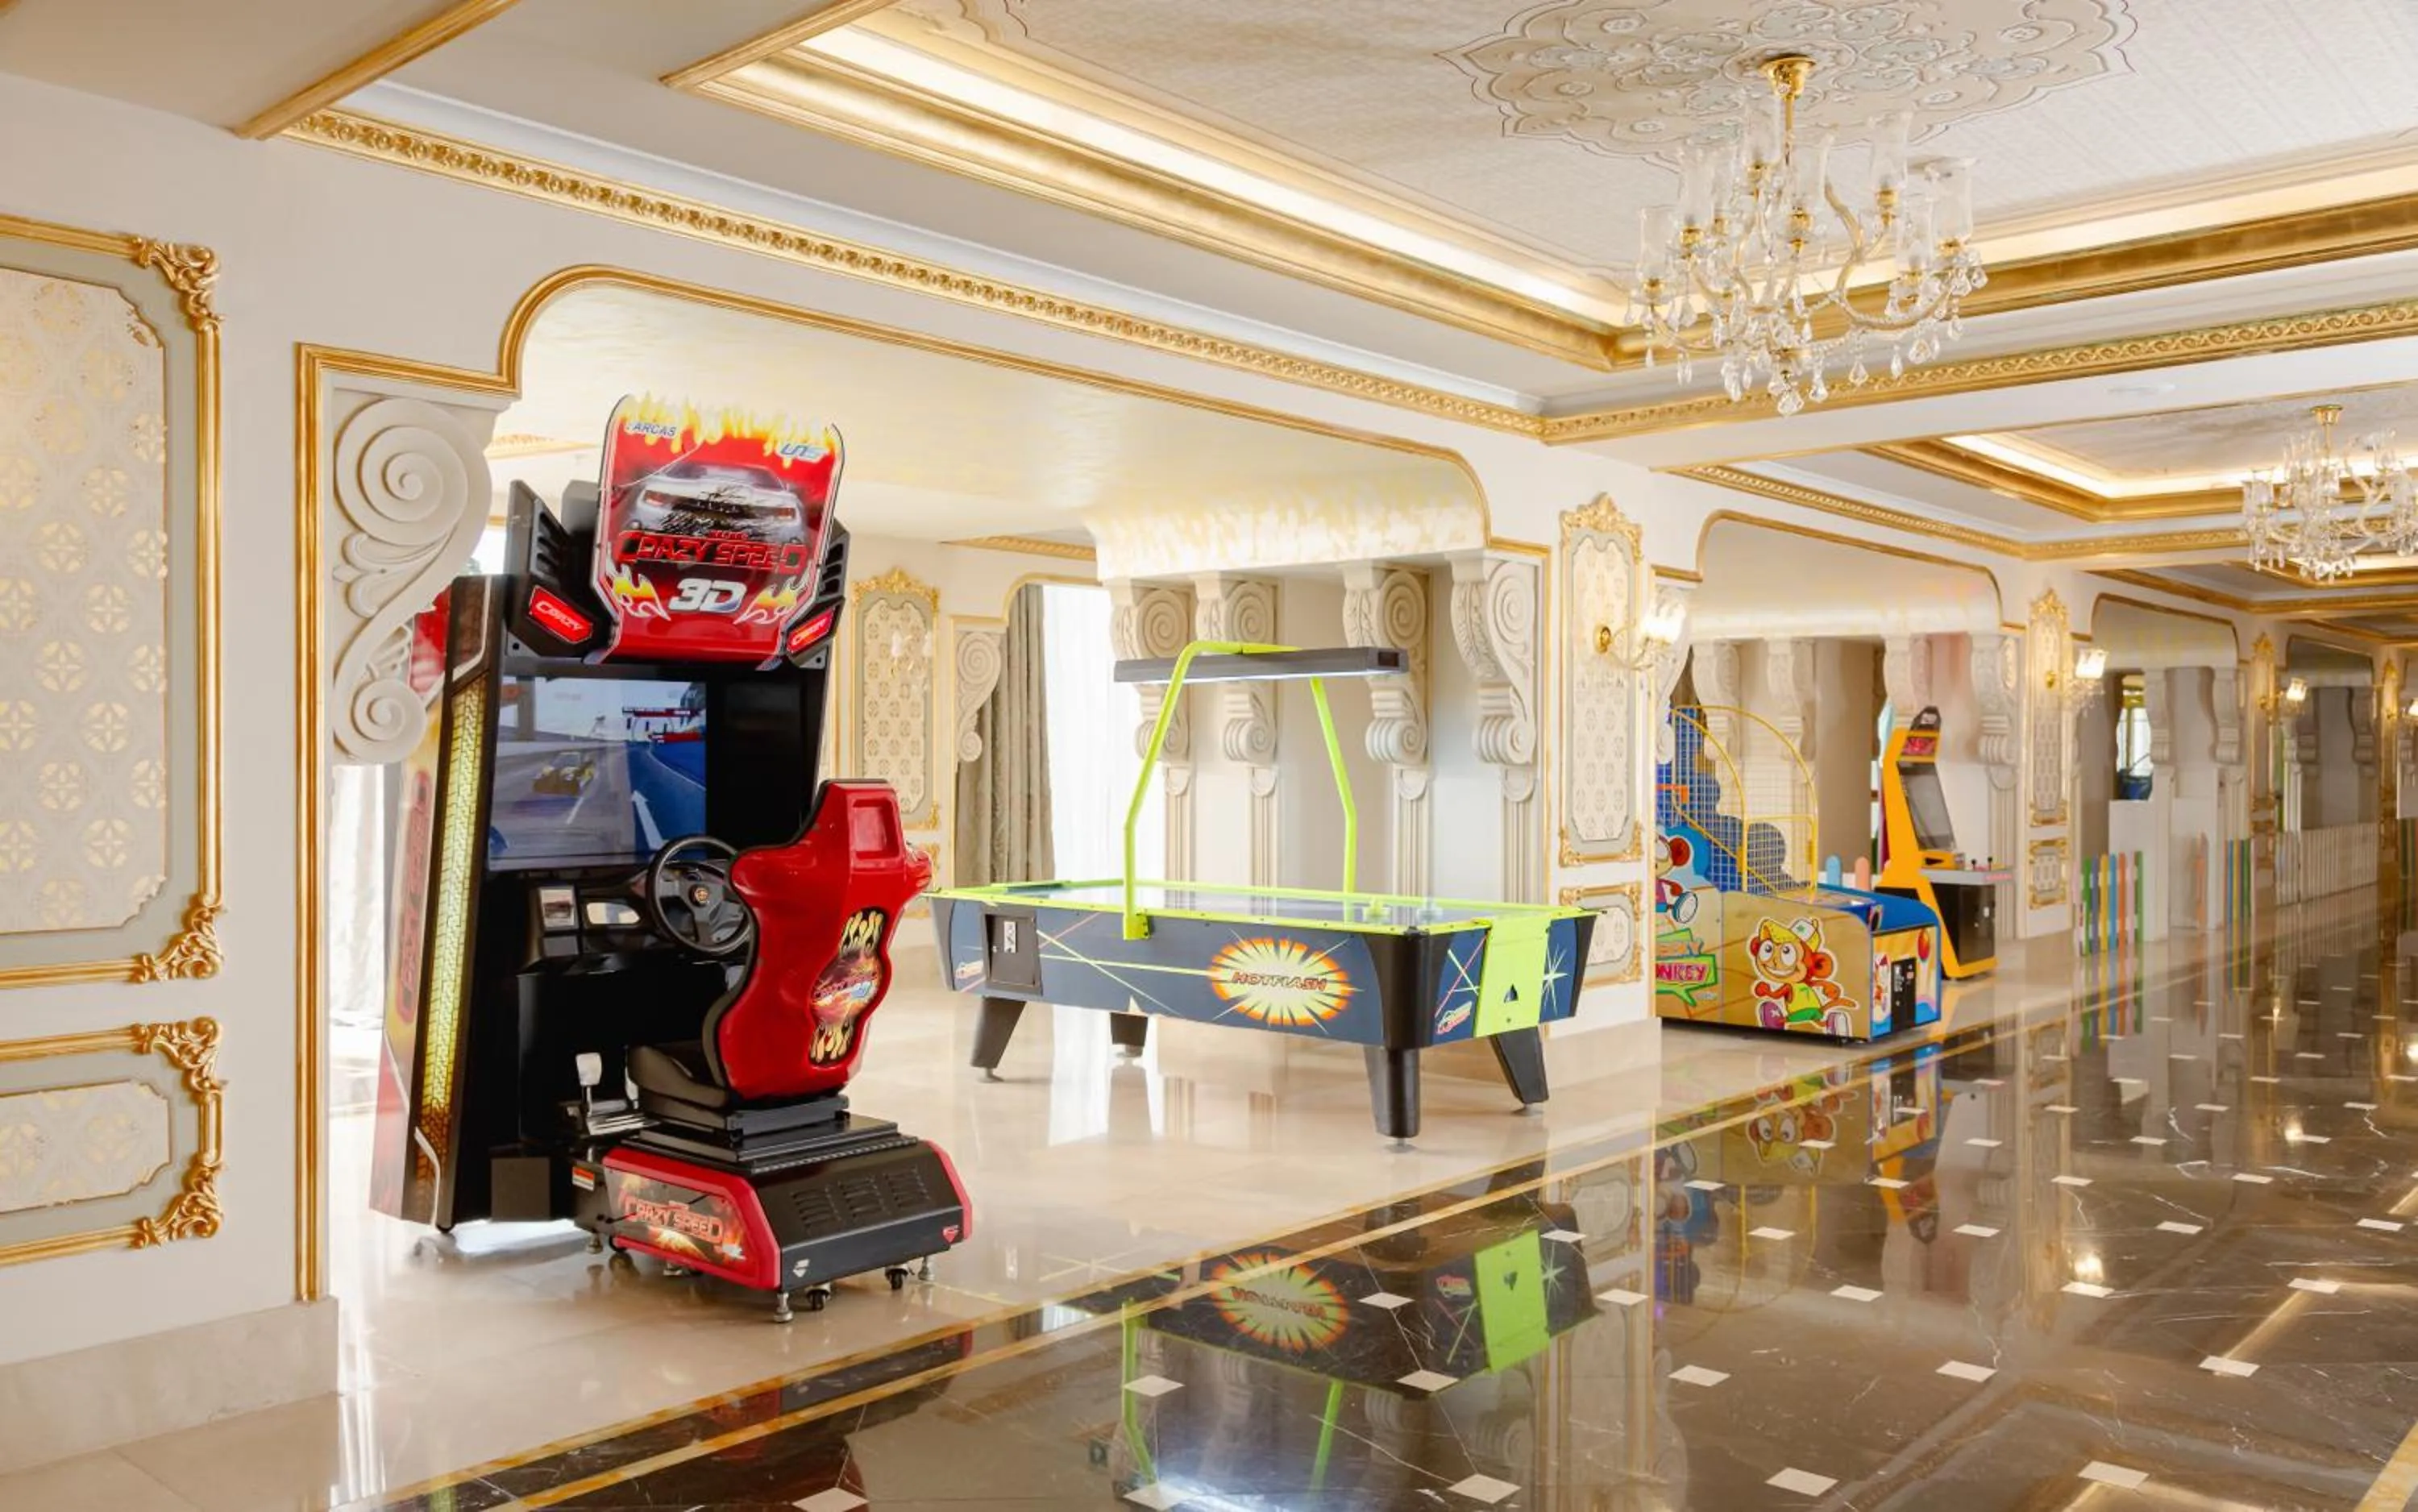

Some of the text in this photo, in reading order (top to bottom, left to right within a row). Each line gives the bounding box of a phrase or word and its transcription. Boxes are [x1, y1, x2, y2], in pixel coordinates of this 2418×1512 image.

[617, 530, 808, 575] CRAZY SPEED
[668, 577, 747, 613] 3D
[1230, 971, 1327, 991] HOTFLASH
[1656, 962, 1708, 982] NKEY
[625, 1197, 724, 1244] CRAZY SPEED
